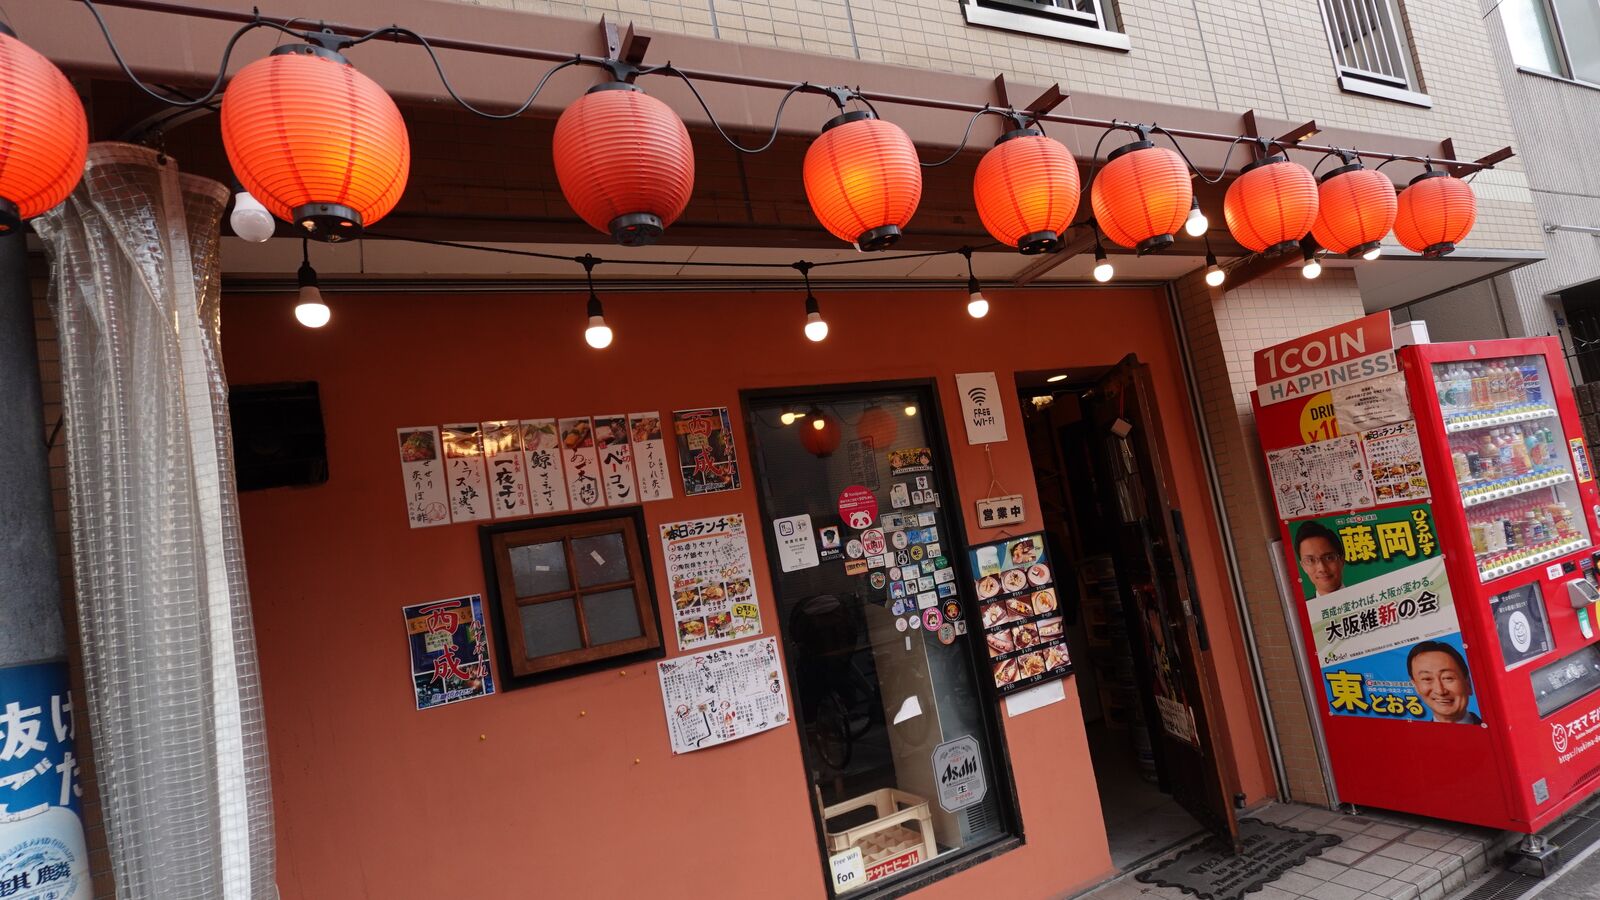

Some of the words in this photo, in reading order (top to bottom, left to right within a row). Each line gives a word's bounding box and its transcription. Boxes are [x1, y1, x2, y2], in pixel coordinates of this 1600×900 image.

[1264, 327, 1366, 379] 1COIN
[1270, 352, 1396, 400] HAPPINESS!
[973, 407, 991, 418] FREE
[973, 416, 995, 427] WI-FI
[681, 410, 723, 477] 西成
[494, 458, 516, 510] 一夜干し
[604, 450, 630, 498] ベーコン
[668, 517, 729, 541] 本日のランチ
[983, 505, 1021, 521] 営業中
[1411, 509, 1434, 556] ひろかず
[1338, 521, 1416, 562] 藤岡
[1321, 576, 1435, 619] 西成が変われば、大阪が変わる。
[1325, 590, 1439, 642] 大阪維新の会
[418, 600, 470, 688] 西成
[1325, 670, 1370, 711] 東
[1369, 693, 1425, 716] とおる
[1565, 713, 1589, 738] スキマ
[941, 755, 978, 785] Asahi
[958, 785, 967, 794] 生
[833, 856, 846, 867] Free
[836, 871, 855, 884] fon
[866, 853, 918, 881] アサヒビール
